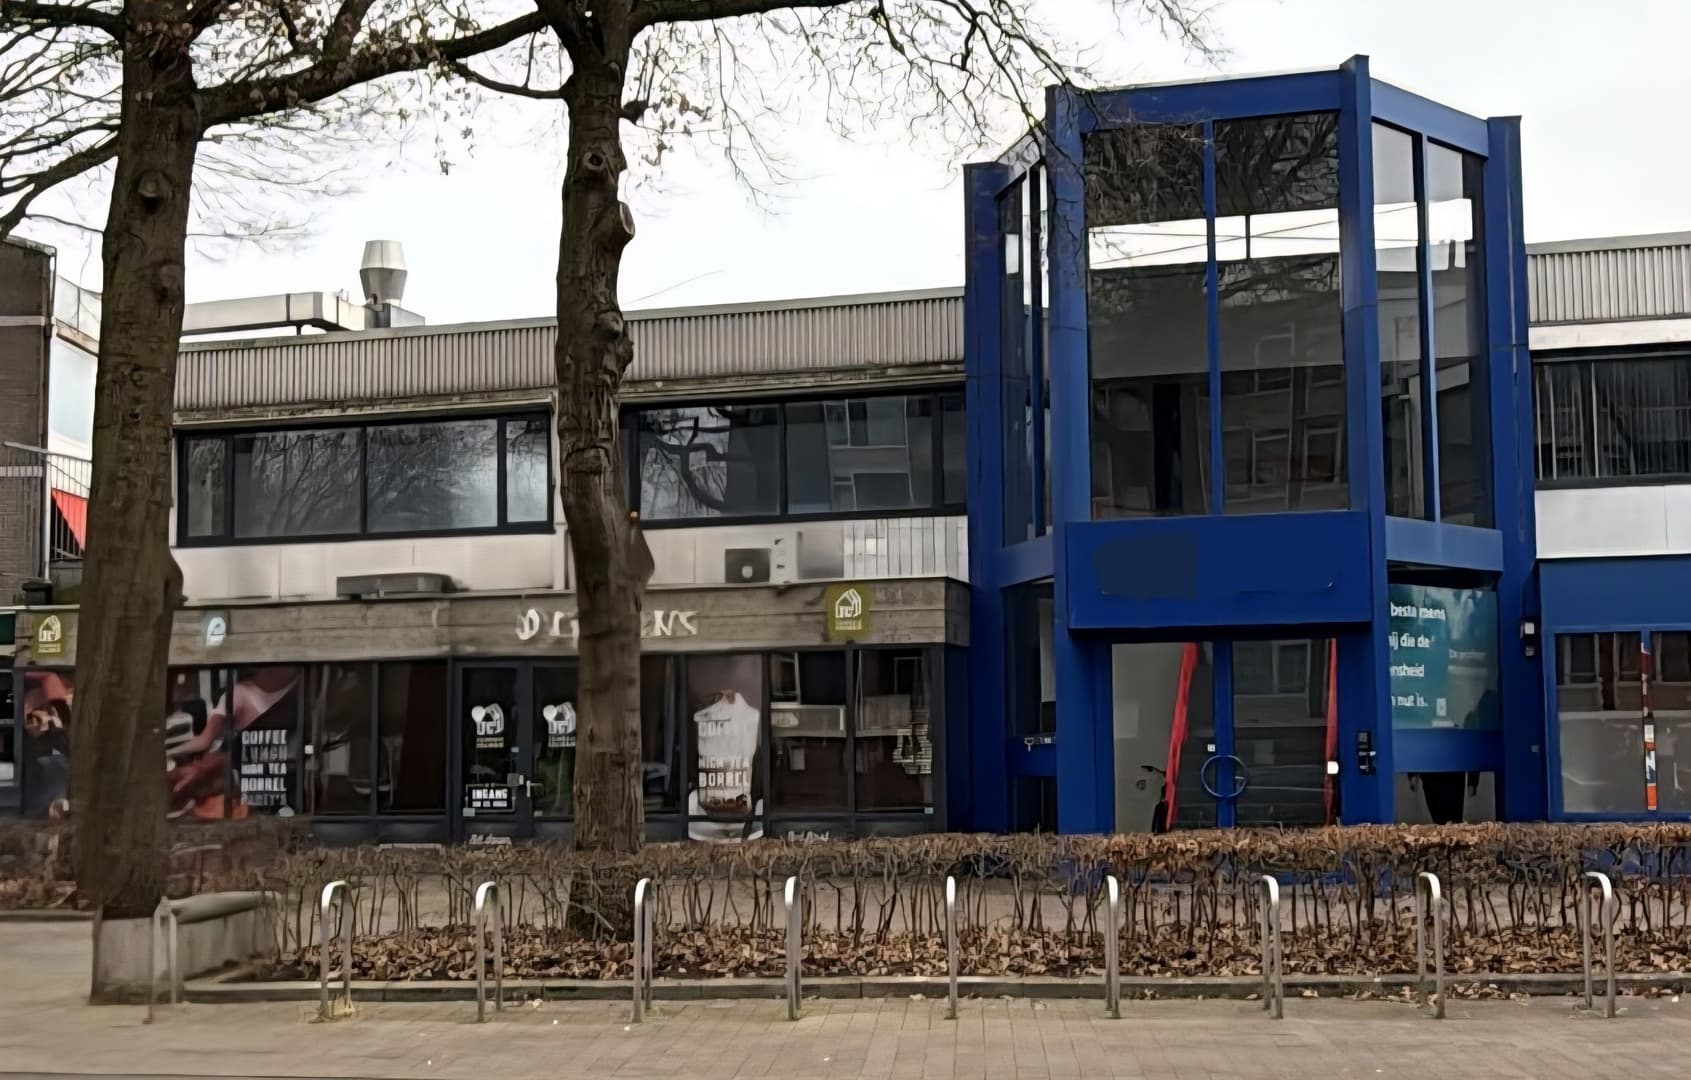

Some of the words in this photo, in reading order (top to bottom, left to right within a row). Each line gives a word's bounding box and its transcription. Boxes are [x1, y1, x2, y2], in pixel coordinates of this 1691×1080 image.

[1388, 632, 1399, 650] ij
[1400, 633, 1416, 648] die
[241, 729, 288, 745] COFFEE
[268, 763, 287, 775] TEA
[241, 776, 287, 792] BORREL
